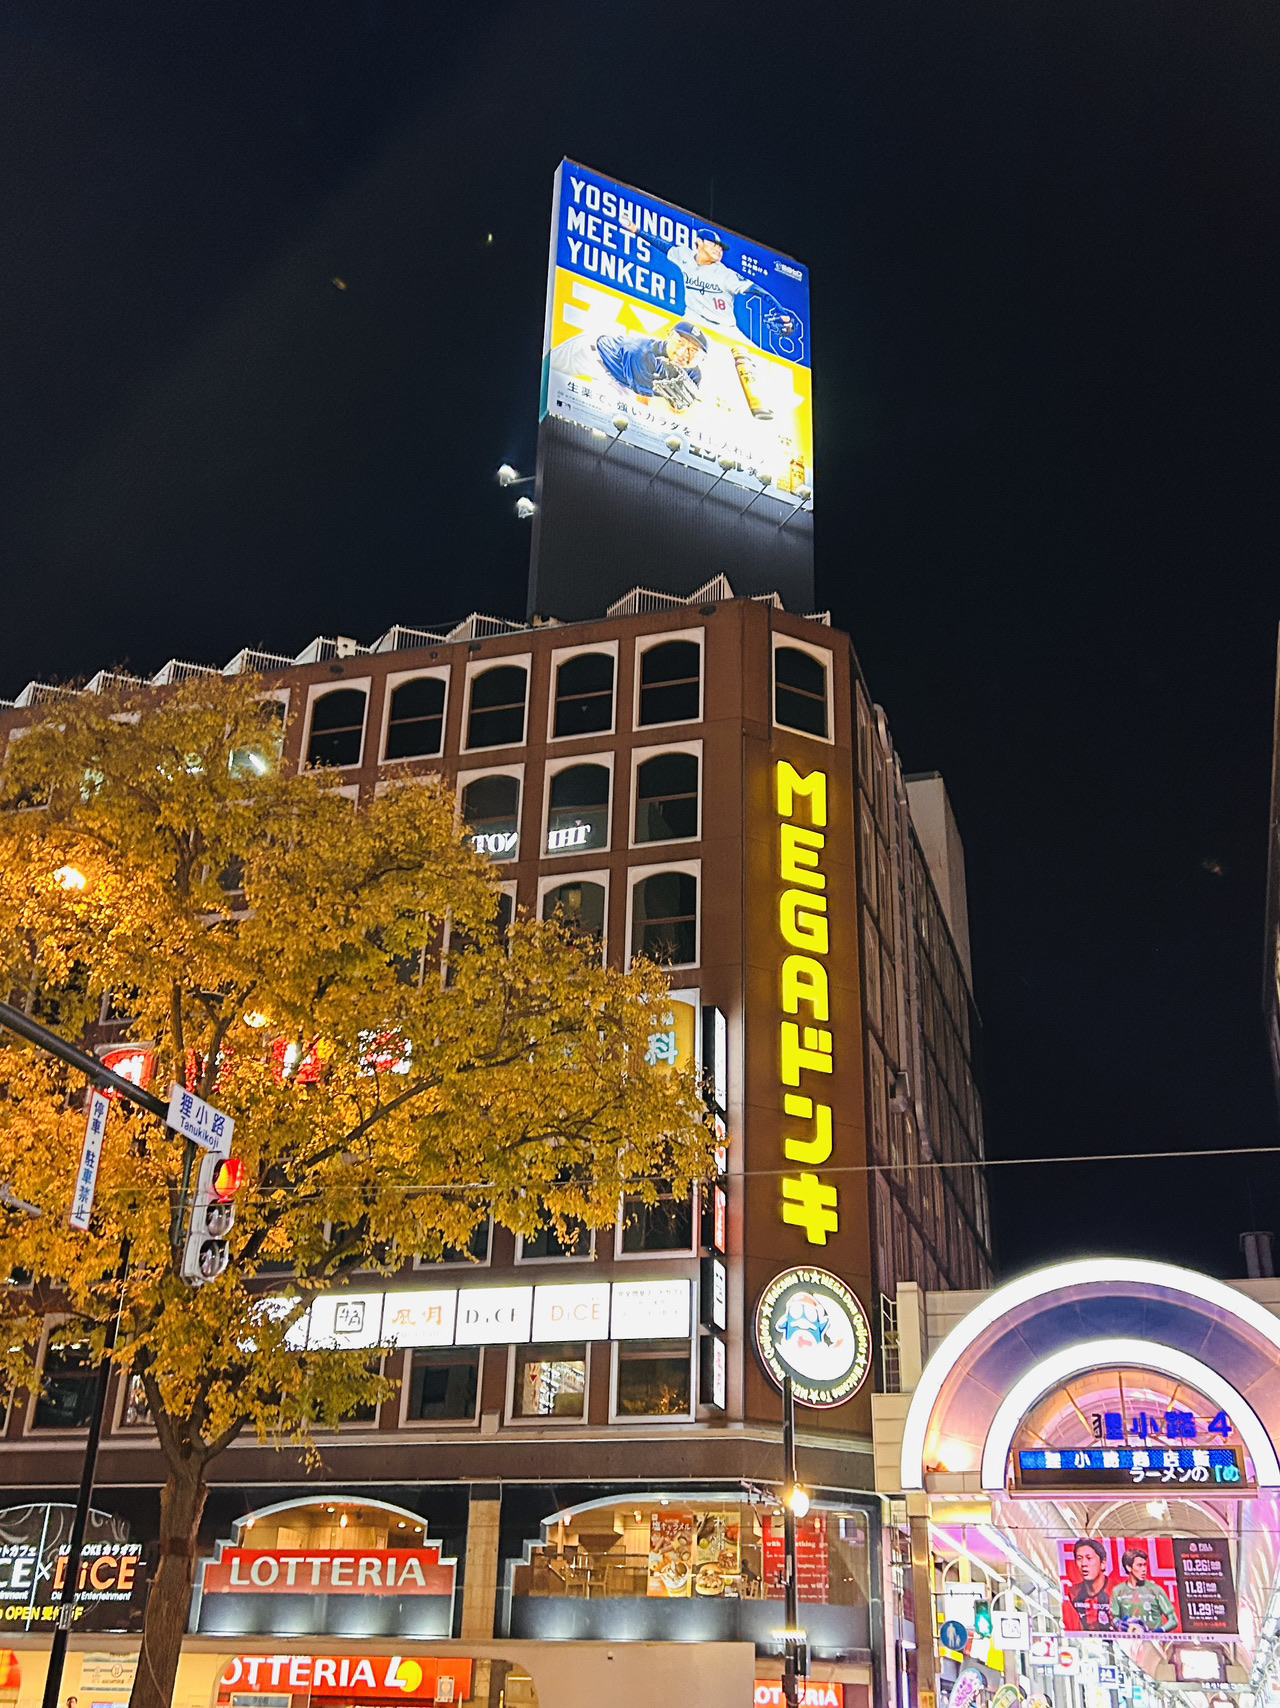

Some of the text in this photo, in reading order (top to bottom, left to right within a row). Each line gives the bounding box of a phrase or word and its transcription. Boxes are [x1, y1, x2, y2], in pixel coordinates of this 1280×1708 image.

[567, 205, 650, 262] MEETS
[567, 236, 676, 304] YUNKER!
[682, 271, 723, 295] Dodgers
[713, 297, 726, 310] 18
[777, 760, 838, 1245] MEGAドンキ
[179, 1092, 225, 1137] 狸小路
[180, 1117, 219, 1150] Tanukikoji
[75, 1100, 105, 1222] 停車・駐車禁止
[551, 1303, 601, 1321] DiCE
[765, 1272, 799, 1307] Welcome
[798, 1270, 810, 1282] To
[821, 1275, 845, 1298] MEGA
[844, 1296, 858, 1315] Don
[853, 1314, 868, 1357] Quijote
[1208, 1411, 1233, 1438] 4
[229, 1556, 427, 1588] LOTTERIA
[1182, 1559, 1208, 1571] 10.26
[1185, 1580, 1203, 1593] 11.8
[5, 1605, 40, 1620] OPEN
[1187, 1602, 1212, 1616] 11.29
[220, 1658, 377, 1689] OTTERIA
[754, 1686, 839, 1707] OTERIA
